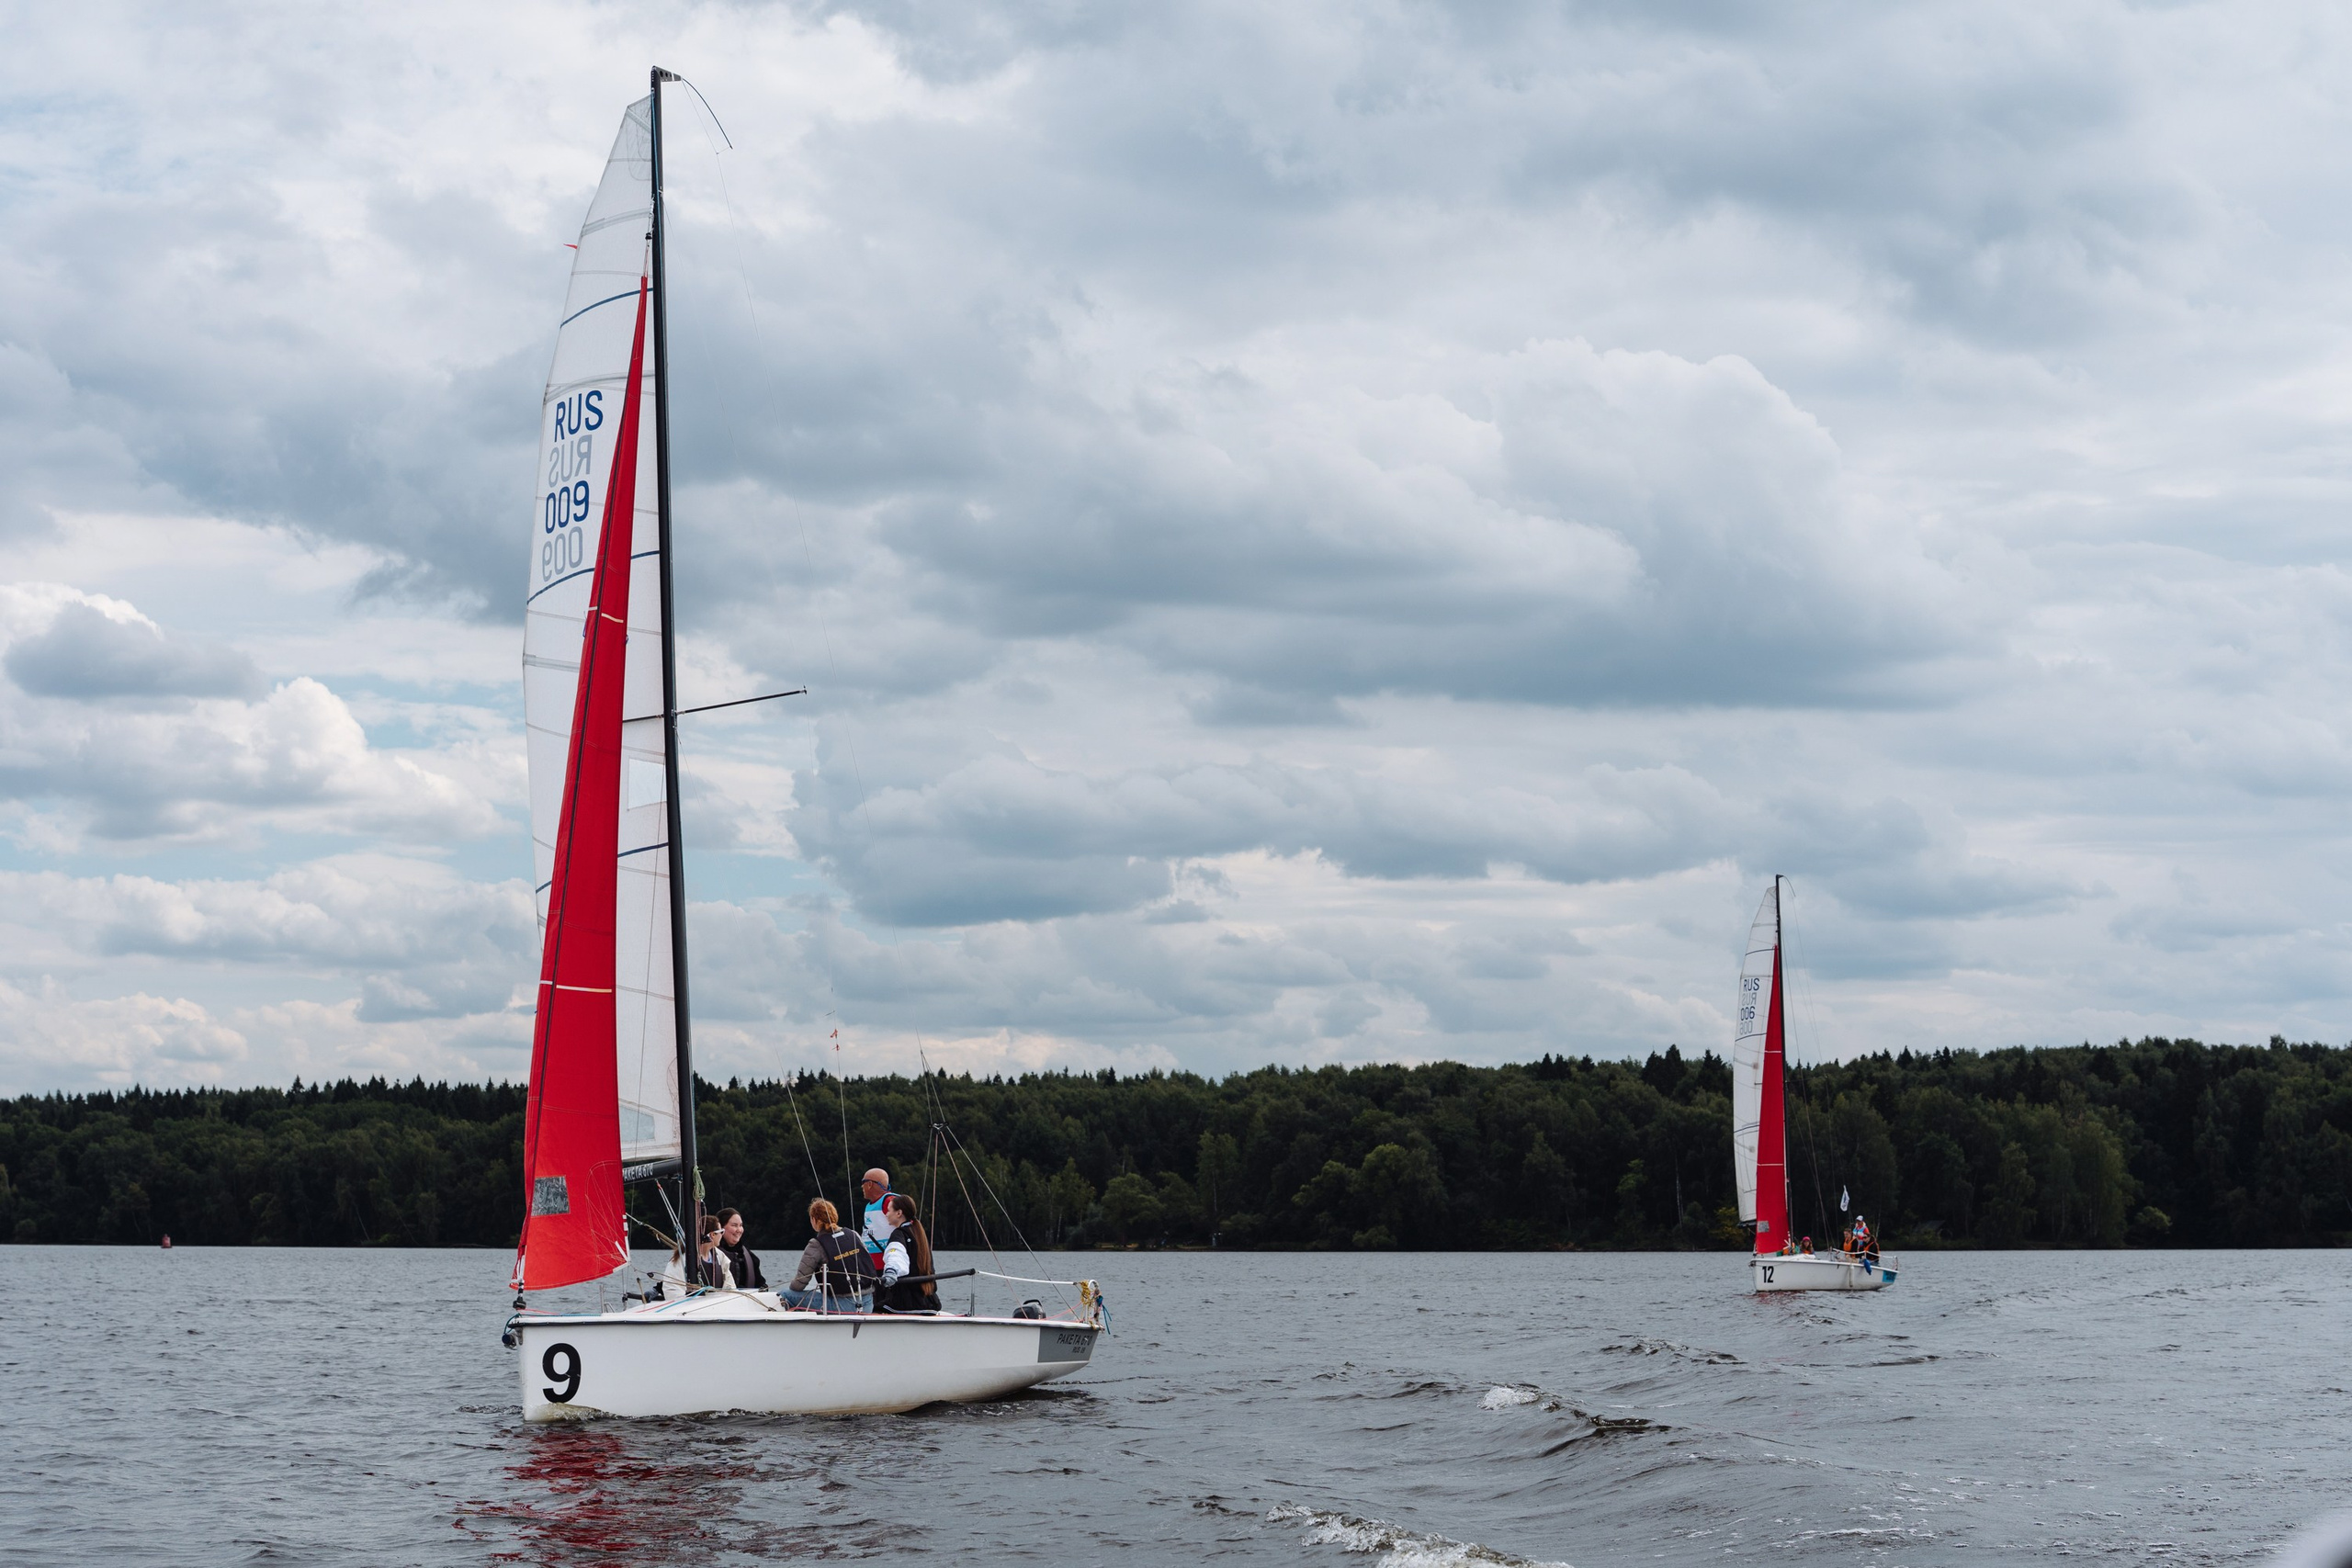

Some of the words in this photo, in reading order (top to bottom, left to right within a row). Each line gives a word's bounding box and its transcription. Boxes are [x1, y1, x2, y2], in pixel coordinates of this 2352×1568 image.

[554, 389, 604, 443] RUS
[545, 479, 590, 534] 009
[1744, 978, 1759, 992] RUS
[1741, 1006, 1755, 1021] 006
[1761, 1266, 1774, 1283] 12
[542, 1342, 582, 1404] 9
